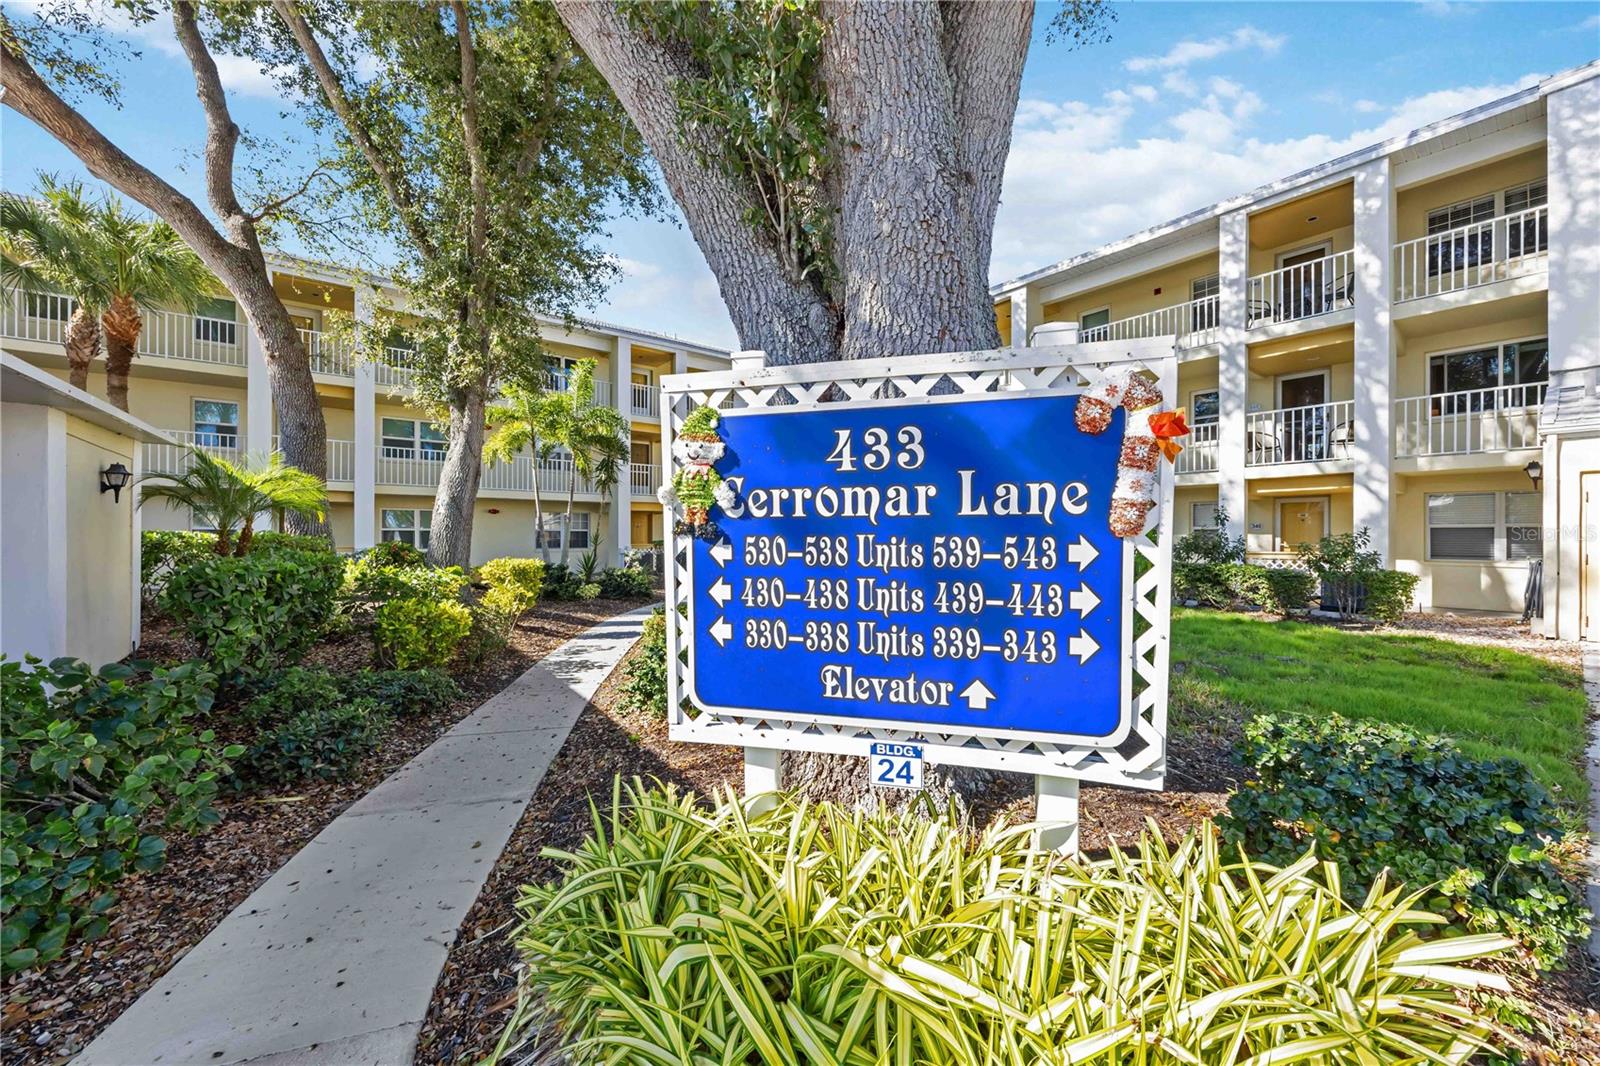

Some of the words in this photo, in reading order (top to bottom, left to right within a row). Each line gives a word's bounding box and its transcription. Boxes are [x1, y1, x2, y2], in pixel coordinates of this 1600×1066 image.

[825, 425, 925, 472] 433
[726, 476, 937, 526] Cerromar
[957, 469, 1089, 525] Lane
[855, 533, 924, 573] Units
[856, 577, 925, 618] Units
[856, 621, 925, 661] Units
[820, 664, 954, 706] Elevator
[876, 744, 916, 757] BLDG.
[877, 758, 914, 784] 24
